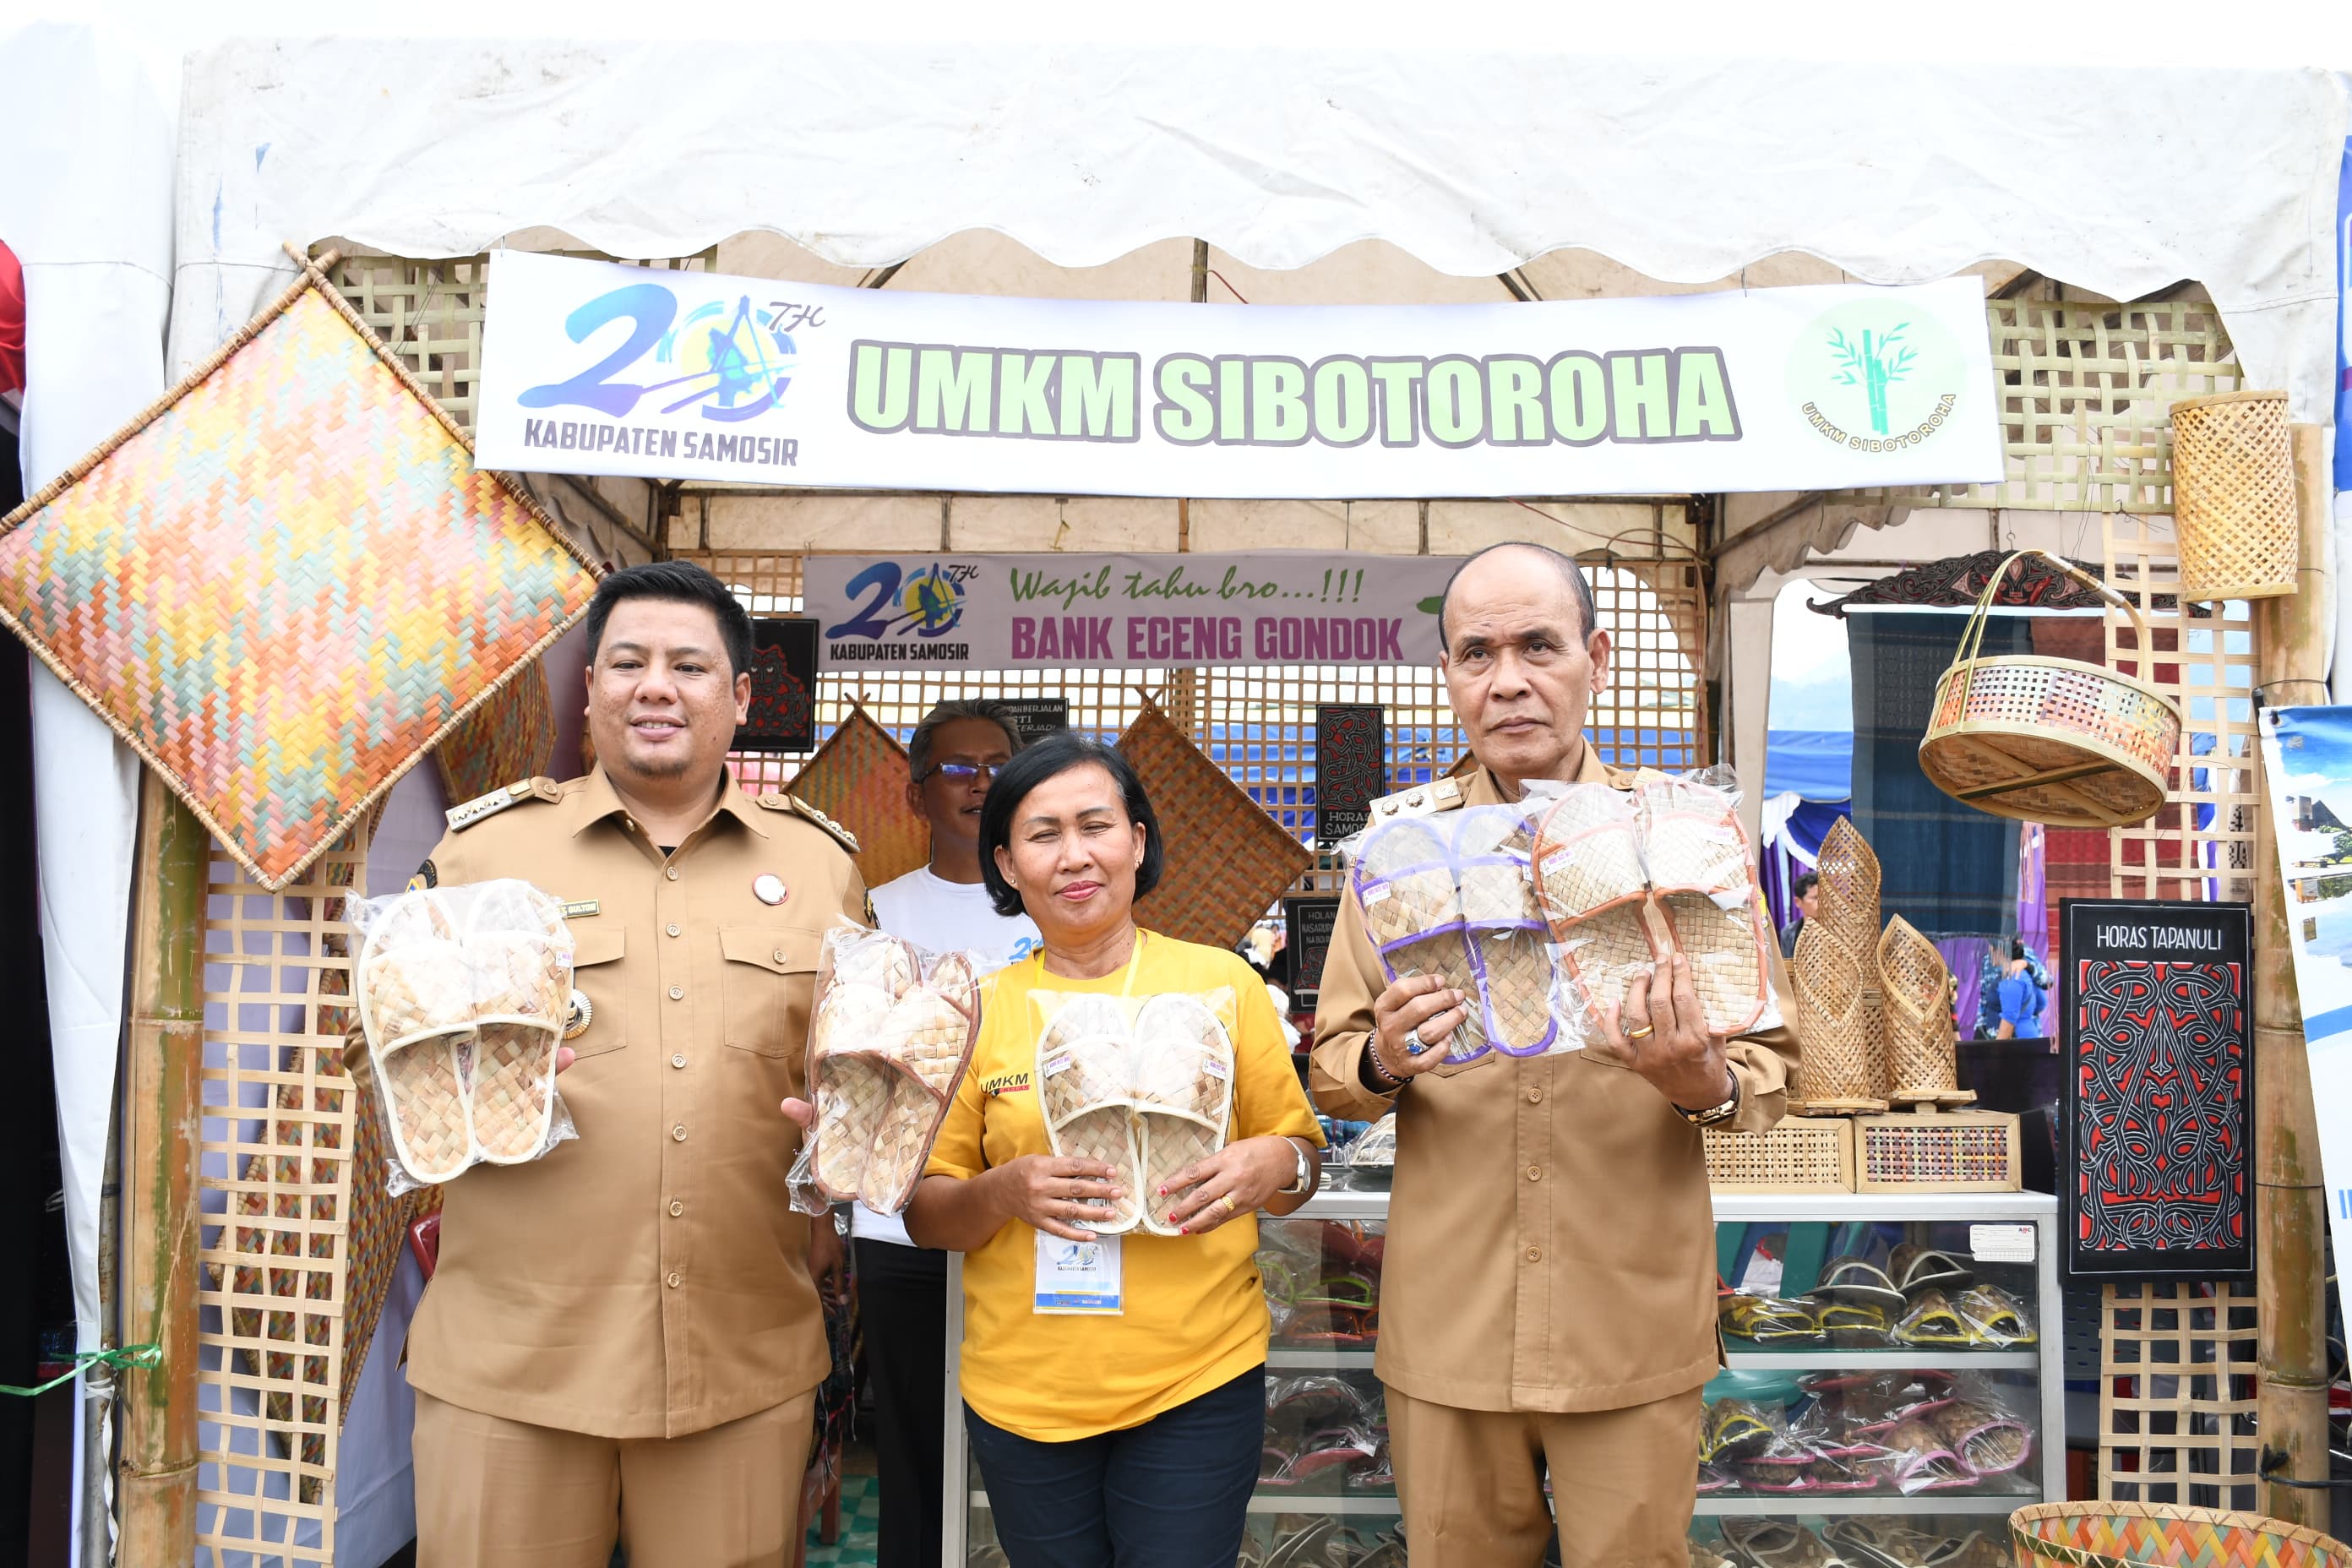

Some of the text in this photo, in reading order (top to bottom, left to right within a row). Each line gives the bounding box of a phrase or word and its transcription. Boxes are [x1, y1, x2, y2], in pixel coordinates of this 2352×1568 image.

[847, 339, 1743, 449] UMKM SIBOTOROHA
[524, 418, 799, 466] KABUPATEN SAMOSIR
[1802, 393, 1957, 453] UMKM SIBOTOROHA
[1010, 564, 1112, 611] Wajib
[1123, 564, 1211, 600] tahu
[830, 643, 970, 662] KABUPATEN SAMOSIR
[1011, 616, 1113, 661] BANK
[1255, 617, 1404, 662] GONDOK
[2097, 924, 2222, 950] HORAS TAPANULI
[980, 1072, 1029, 1093] UMKM
